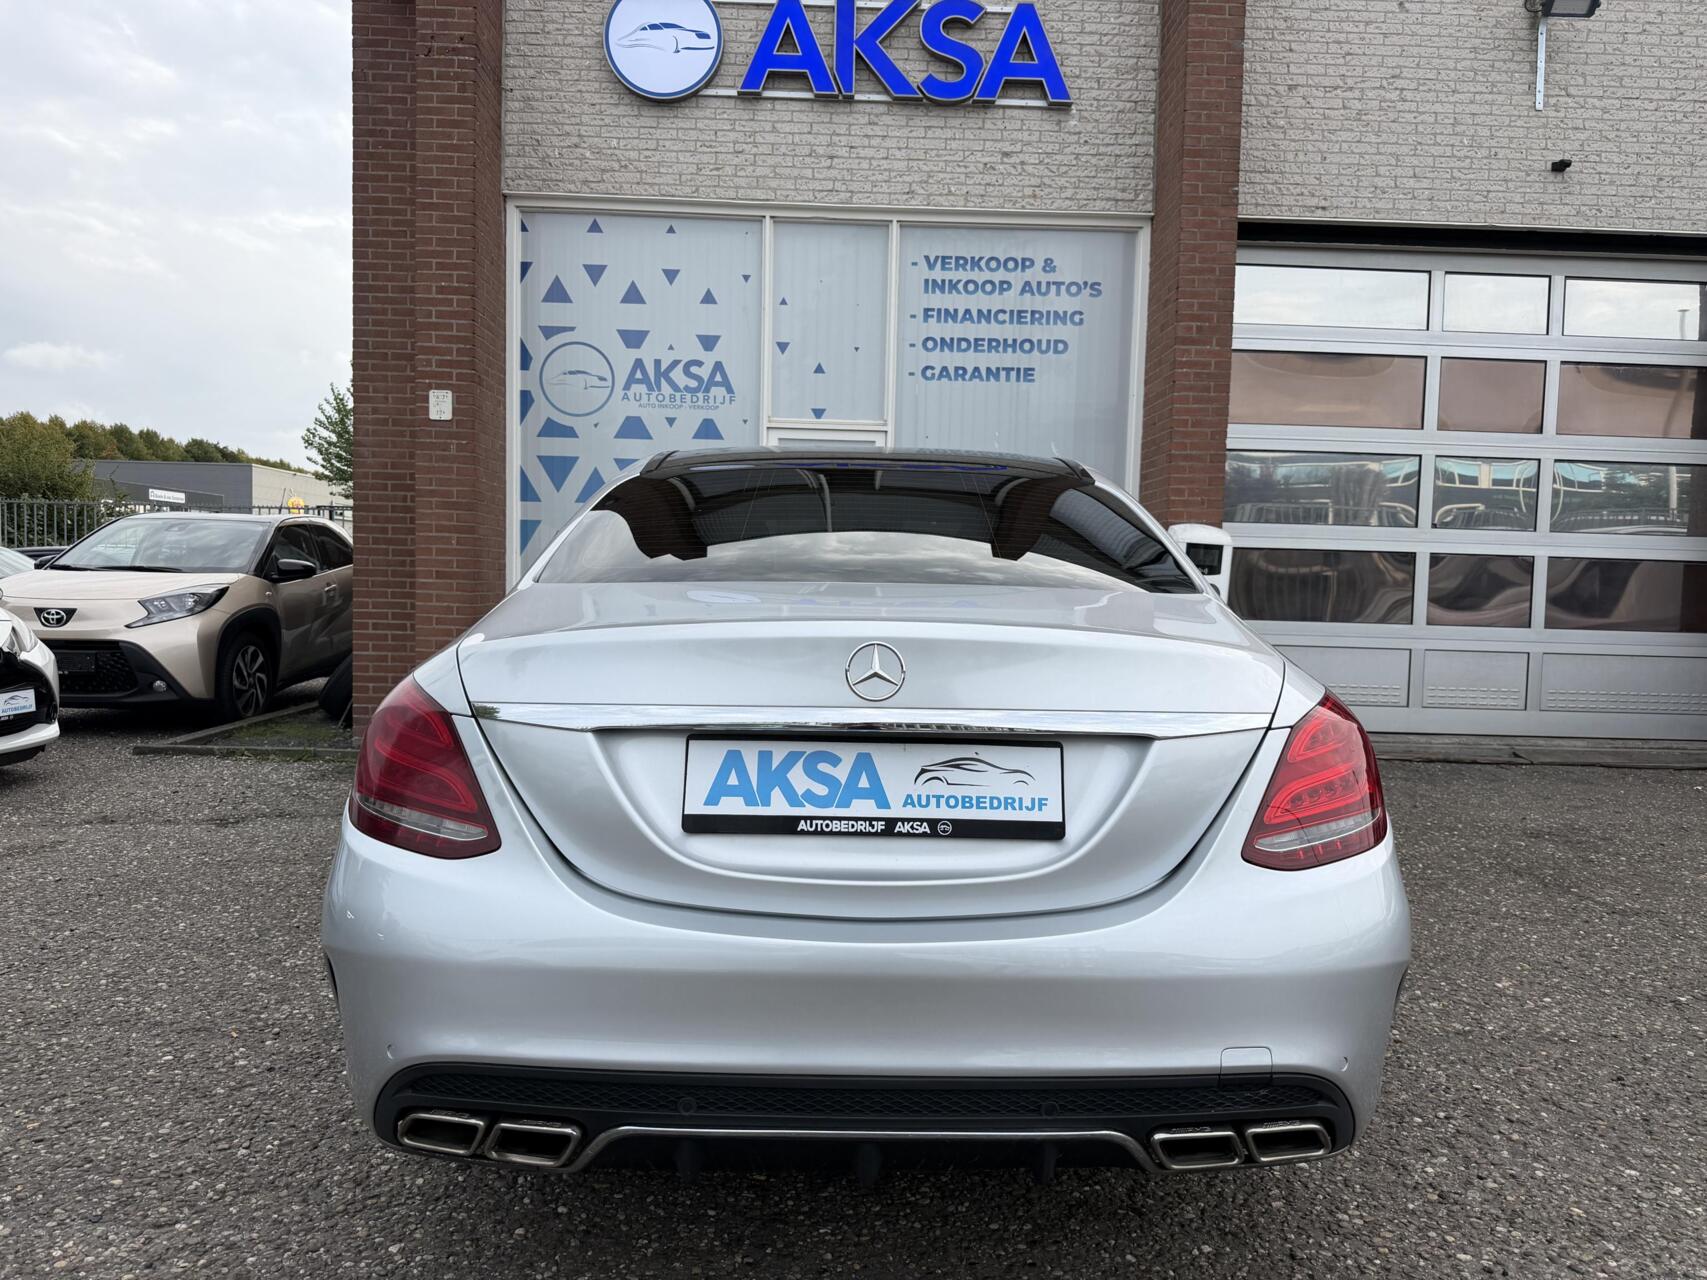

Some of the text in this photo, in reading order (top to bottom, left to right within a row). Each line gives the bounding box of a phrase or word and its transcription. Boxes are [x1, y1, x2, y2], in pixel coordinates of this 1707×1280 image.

[737, 0, 1073, 107] AKSA
[923, 255, 1035, 273] VERKOOP
[1041, 257, 1057, 274] &
[923, 278, 1103, 298] INKOOP AUTO'S
[922, 307, 1085, 327] FINANCIERING
[921, 336, 1069, 355] ONDERHOUD
[622, 358, 735, 395] AKSA
[920, 365, 1036, 383] GARANTIE
[621, 392, 737, 405] AUTOBEDRIJF
[703, 749, 1049, 812] AKSA AUTOBEDRIJF
[797, 819, 931, 834] AUTOBEDRIJF AKSA
